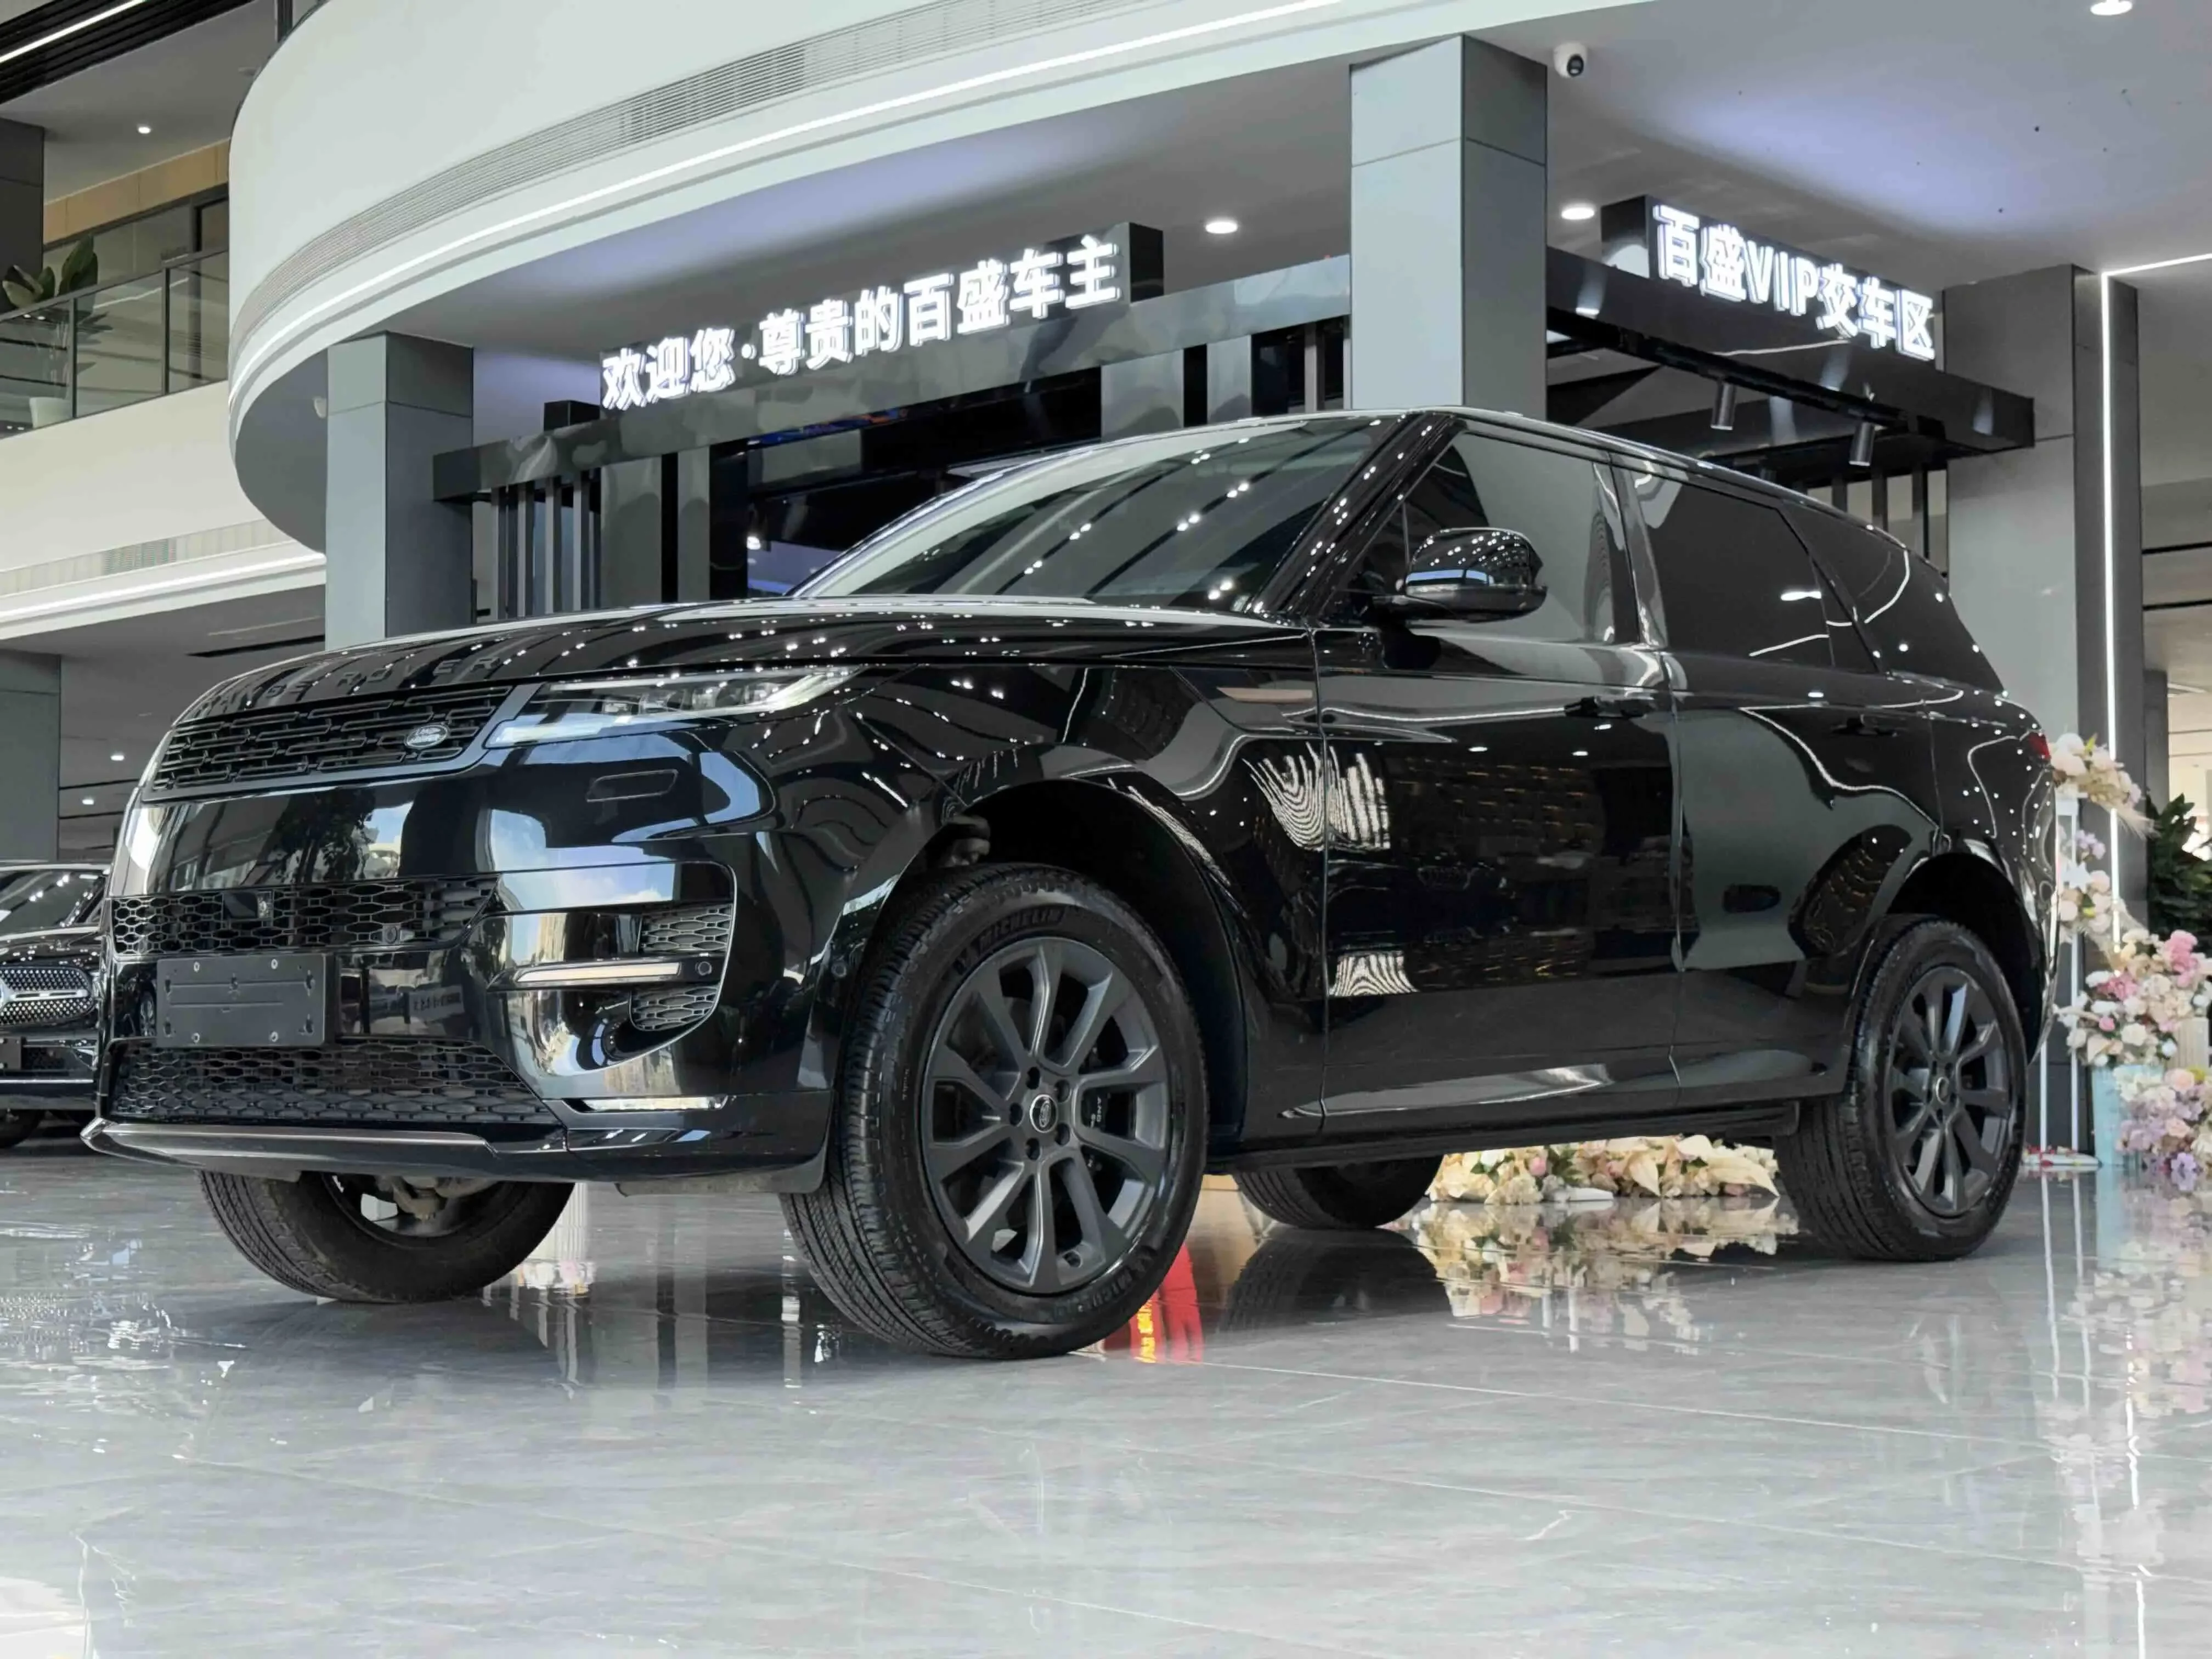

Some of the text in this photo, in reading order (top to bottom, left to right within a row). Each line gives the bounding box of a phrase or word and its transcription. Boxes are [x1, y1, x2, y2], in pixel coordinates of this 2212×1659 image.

[602, 235, 1121, 410] 欢迎您·尊贵的百盛车主
[1653, 205, 1935, 361] 百盛VIP交车区
[337, 657, 500, 687] ROVER
